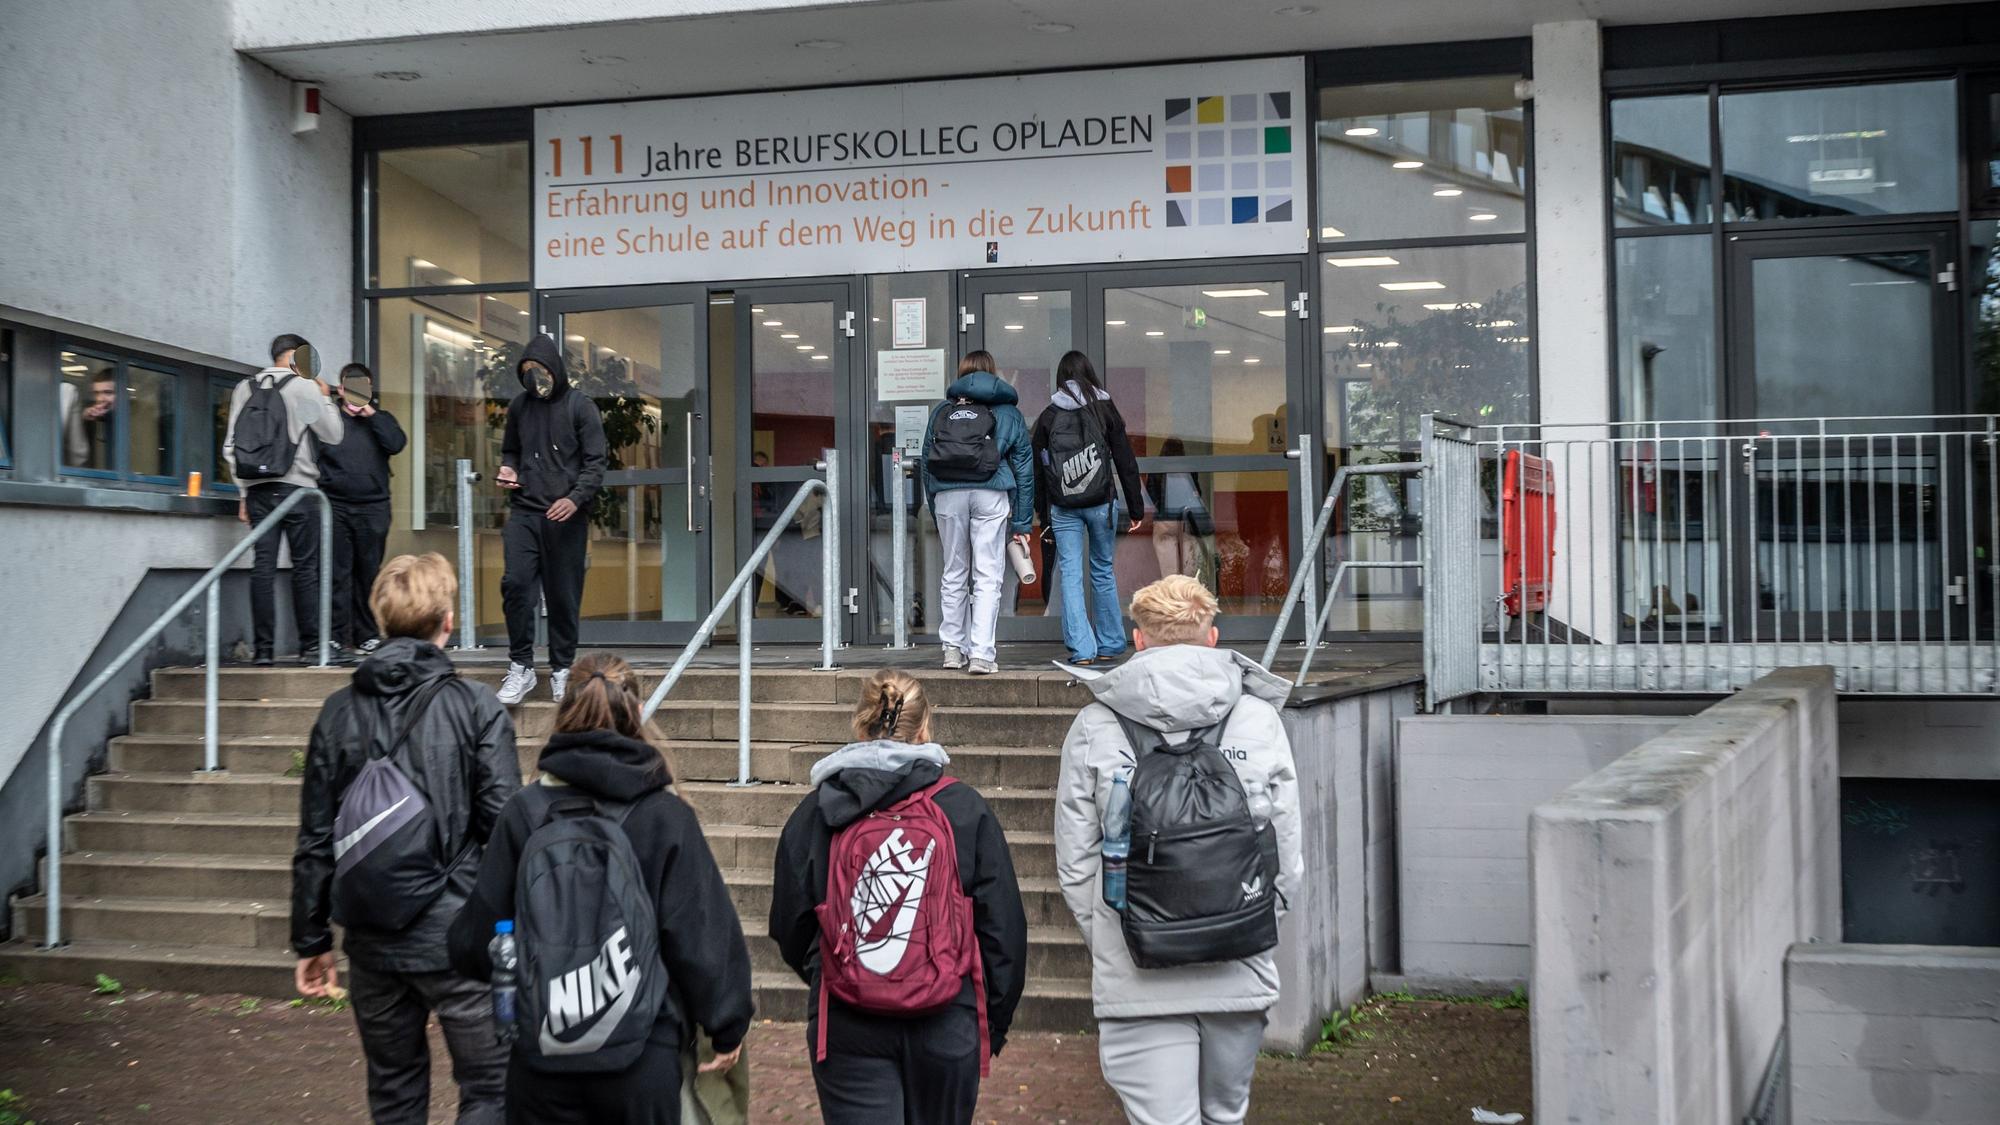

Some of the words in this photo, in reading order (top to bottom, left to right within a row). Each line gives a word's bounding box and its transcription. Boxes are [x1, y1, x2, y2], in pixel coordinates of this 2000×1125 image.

[548, 134, 624, 178] 111
[640, 142, 723, 178] Jahre
[735, 125, 978, 167] BERUFSKOLLEG
[992, 114, 1153, 152] OPLADEN
[547, 183, 689, 218] Erfahrung
[699, 180, 756, 210] und
[767, 173, 929, 206] Innovation
[547, 232, 605, 258] eine
[616, 224, 710, 255] Schule
[721, 219, 769, 250] auf
[778, 219, 842, 247] dem
[852, 210, 917, 247] Weg
[929, 213, 955, 239] in
[968, 208, 1014, 238] die
[1026, 199, 1152, 235] Zukunft
[1063, 443, 1098, 485] NIKE
[851, 828, 925, 939] NIKE
[549, 926, 637, 1036] NIKE
